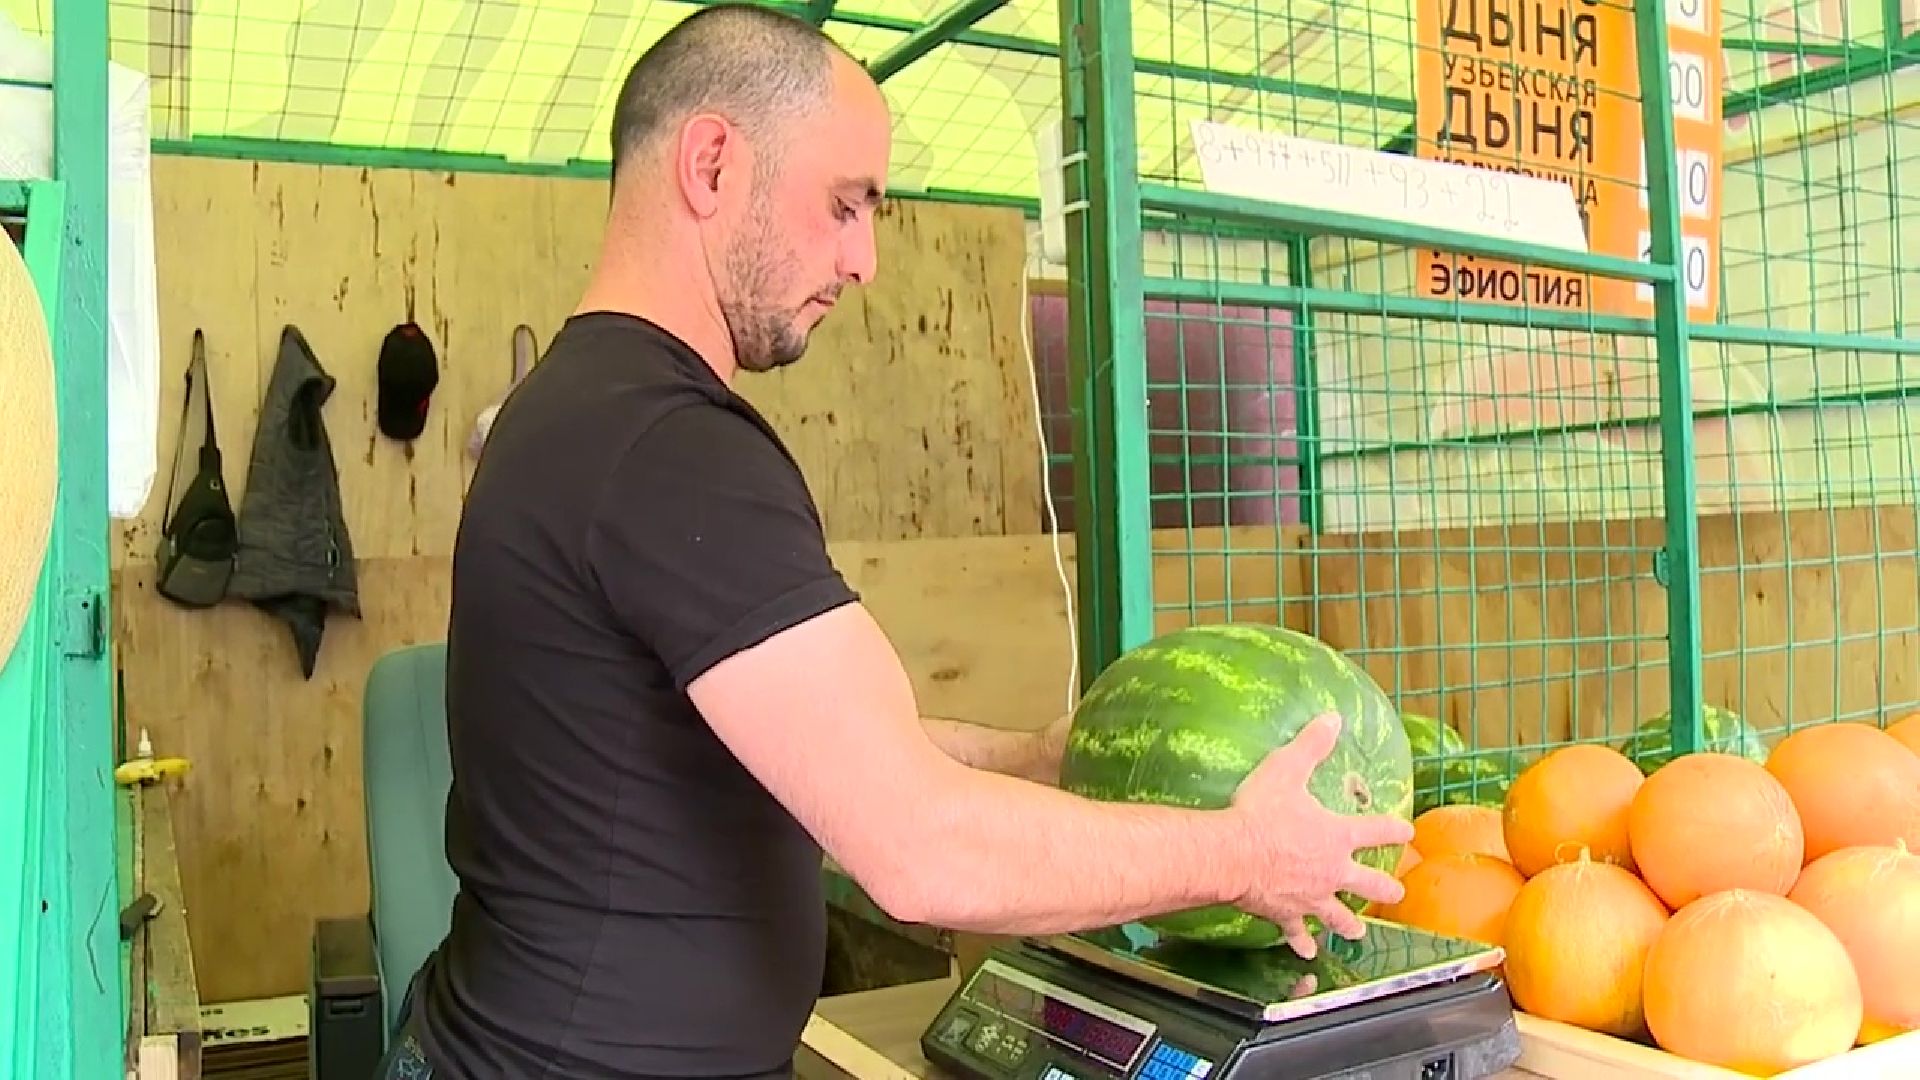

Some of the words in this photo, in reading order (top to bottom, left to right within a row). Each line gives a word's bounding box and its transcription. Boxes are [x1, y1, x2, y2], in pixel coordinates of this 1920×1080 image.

[1442, 0, 1597, 67] ДЫНЯ
[1444, 51, 1597, 108] УЗБЕКСКАЯ
[1437, 87, 1594, 163] ДЫНЯ
